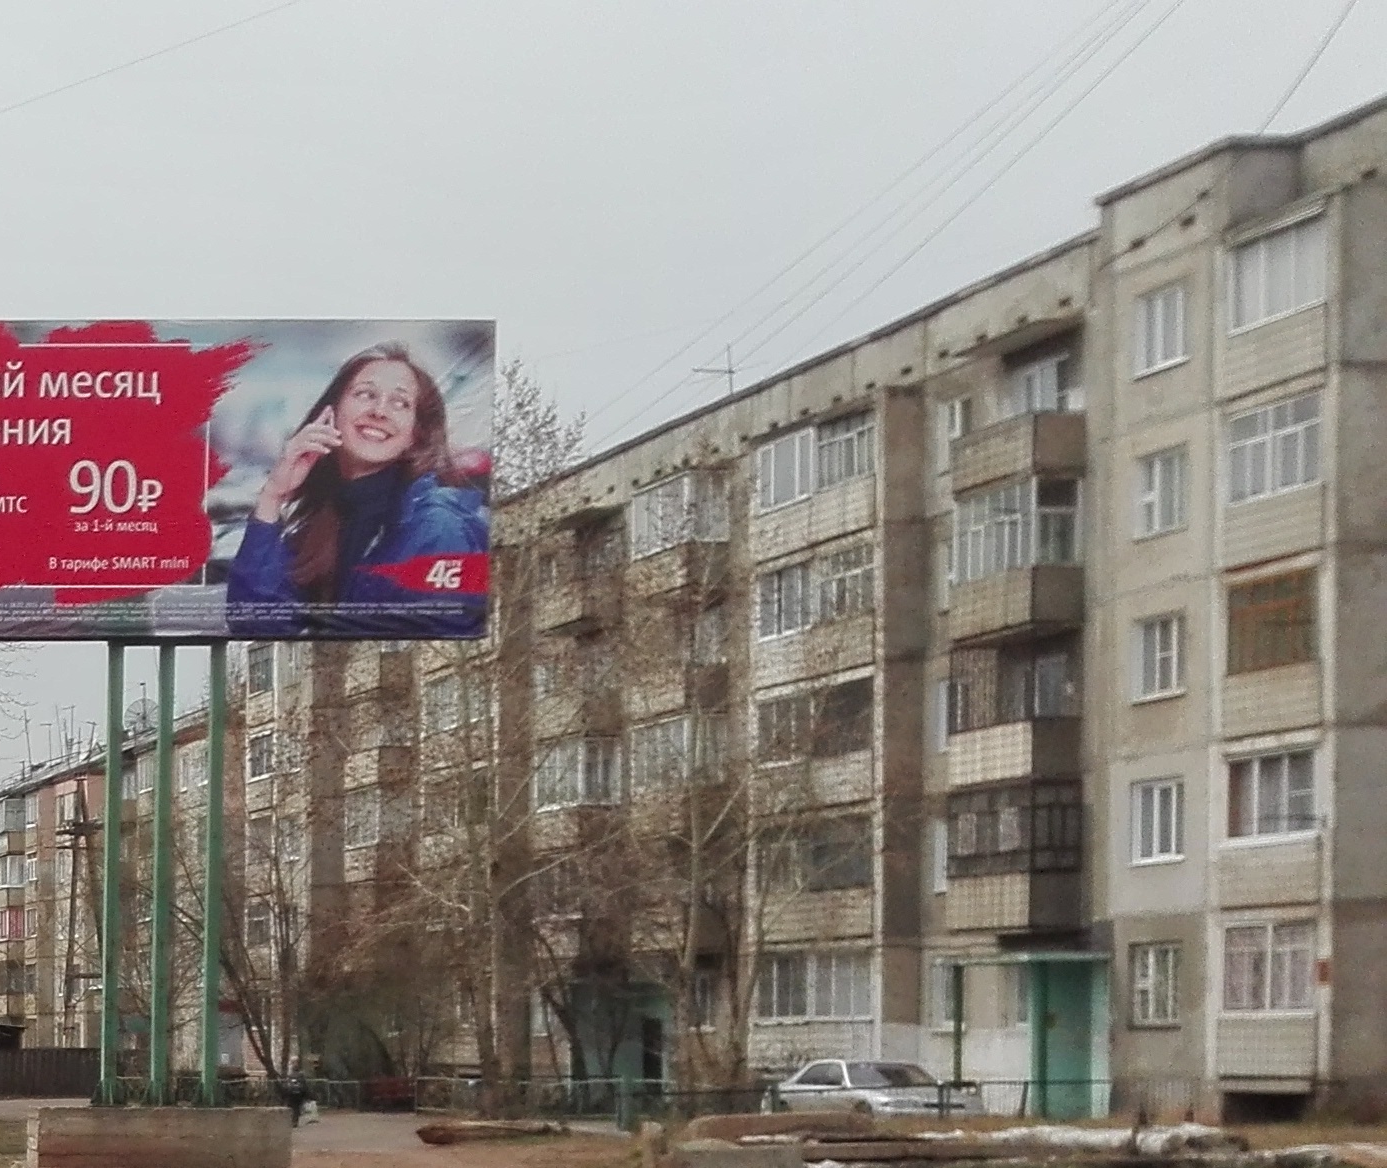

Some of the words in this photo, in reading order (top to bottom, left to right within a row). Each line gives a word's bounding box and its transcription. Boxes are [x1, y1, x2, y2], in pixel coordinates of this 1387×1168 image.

[39, 370, 162, 405] месяц
[74, 522, 89, 533] за
[92, 519, 113, 533] 1-й
[116, 522, 159, 534] месяц
[49, 556, 57, 570] В
[60, 555, 109, 572] тарифе
[112, 556, 157, 570] SMART
[159, 556, 190, 570] mini
[425, 559, 463, 589] 4G
